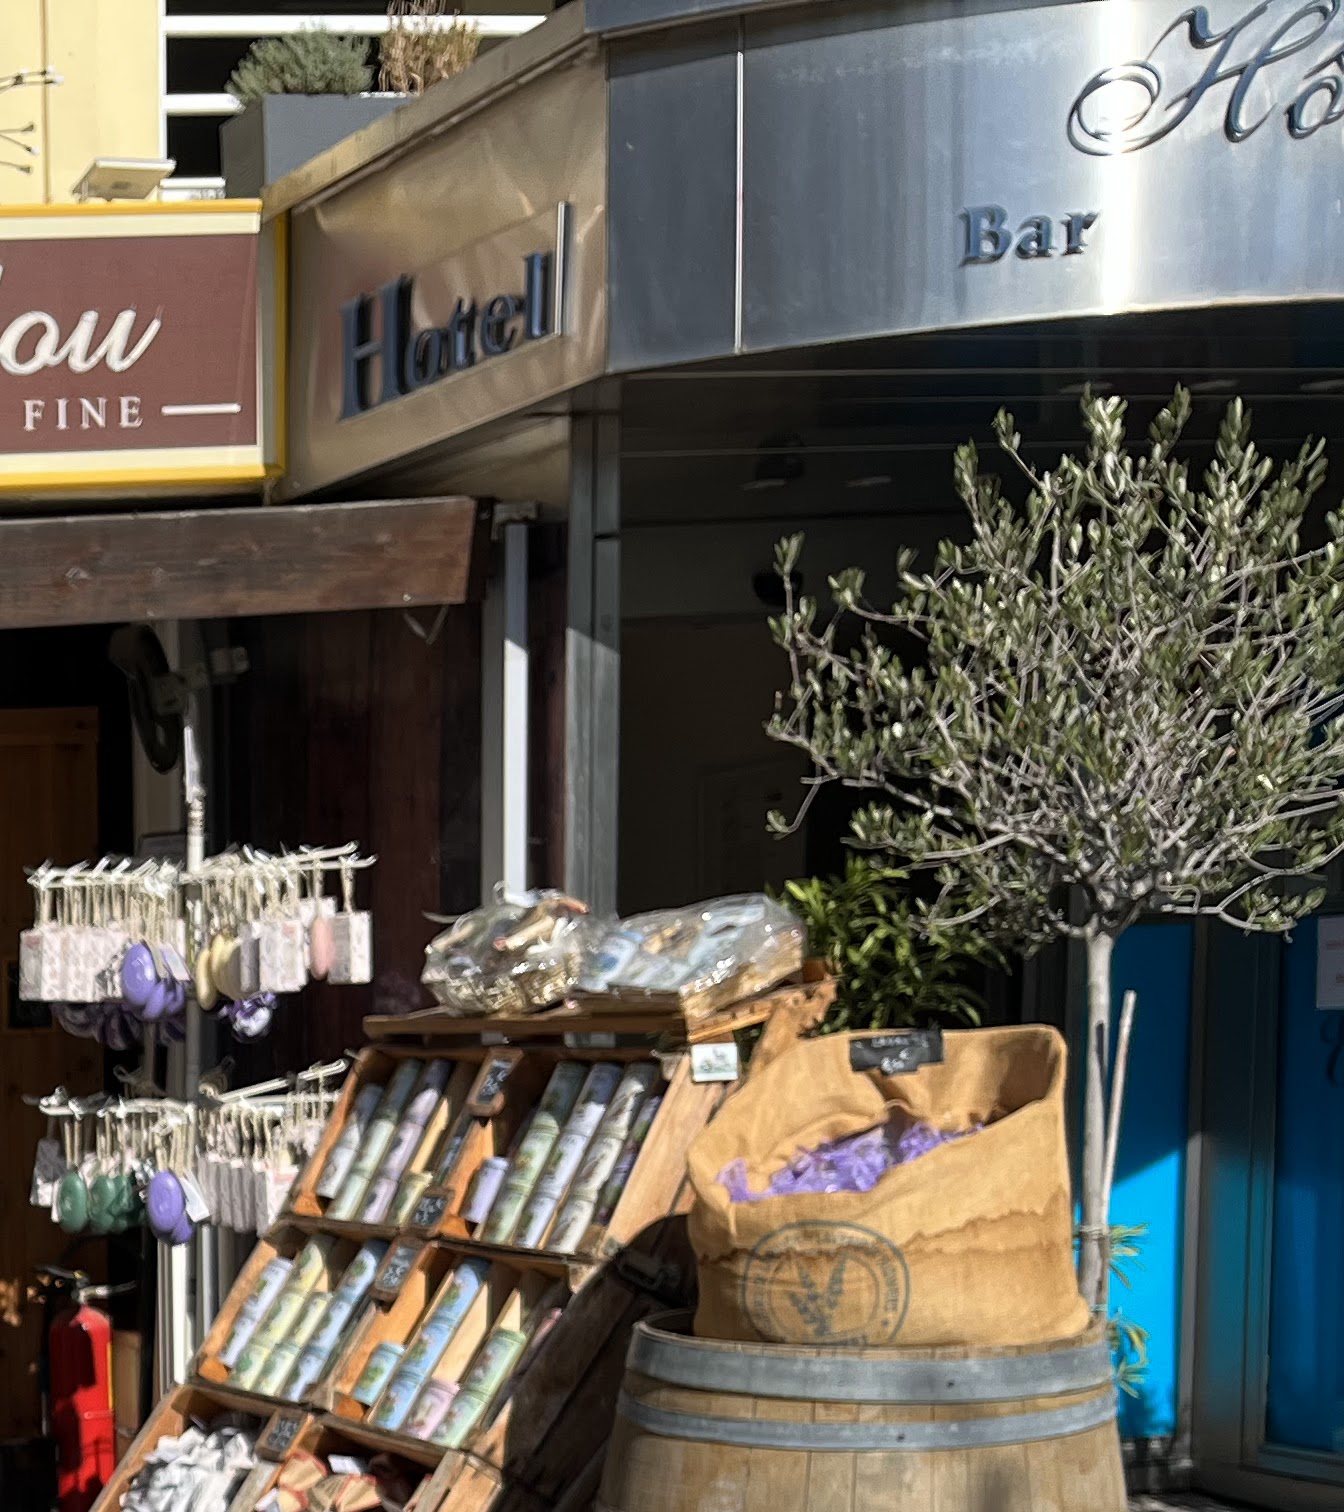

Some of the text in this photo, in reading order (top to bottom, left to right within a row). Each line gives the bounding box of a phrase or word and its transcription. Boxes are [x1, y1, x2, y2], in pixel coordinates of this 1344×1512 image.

[958, 204, 1100, 267] Bar
[339, 251, 553, 422] Hotel
[23, 395, 144, 432] FINE
